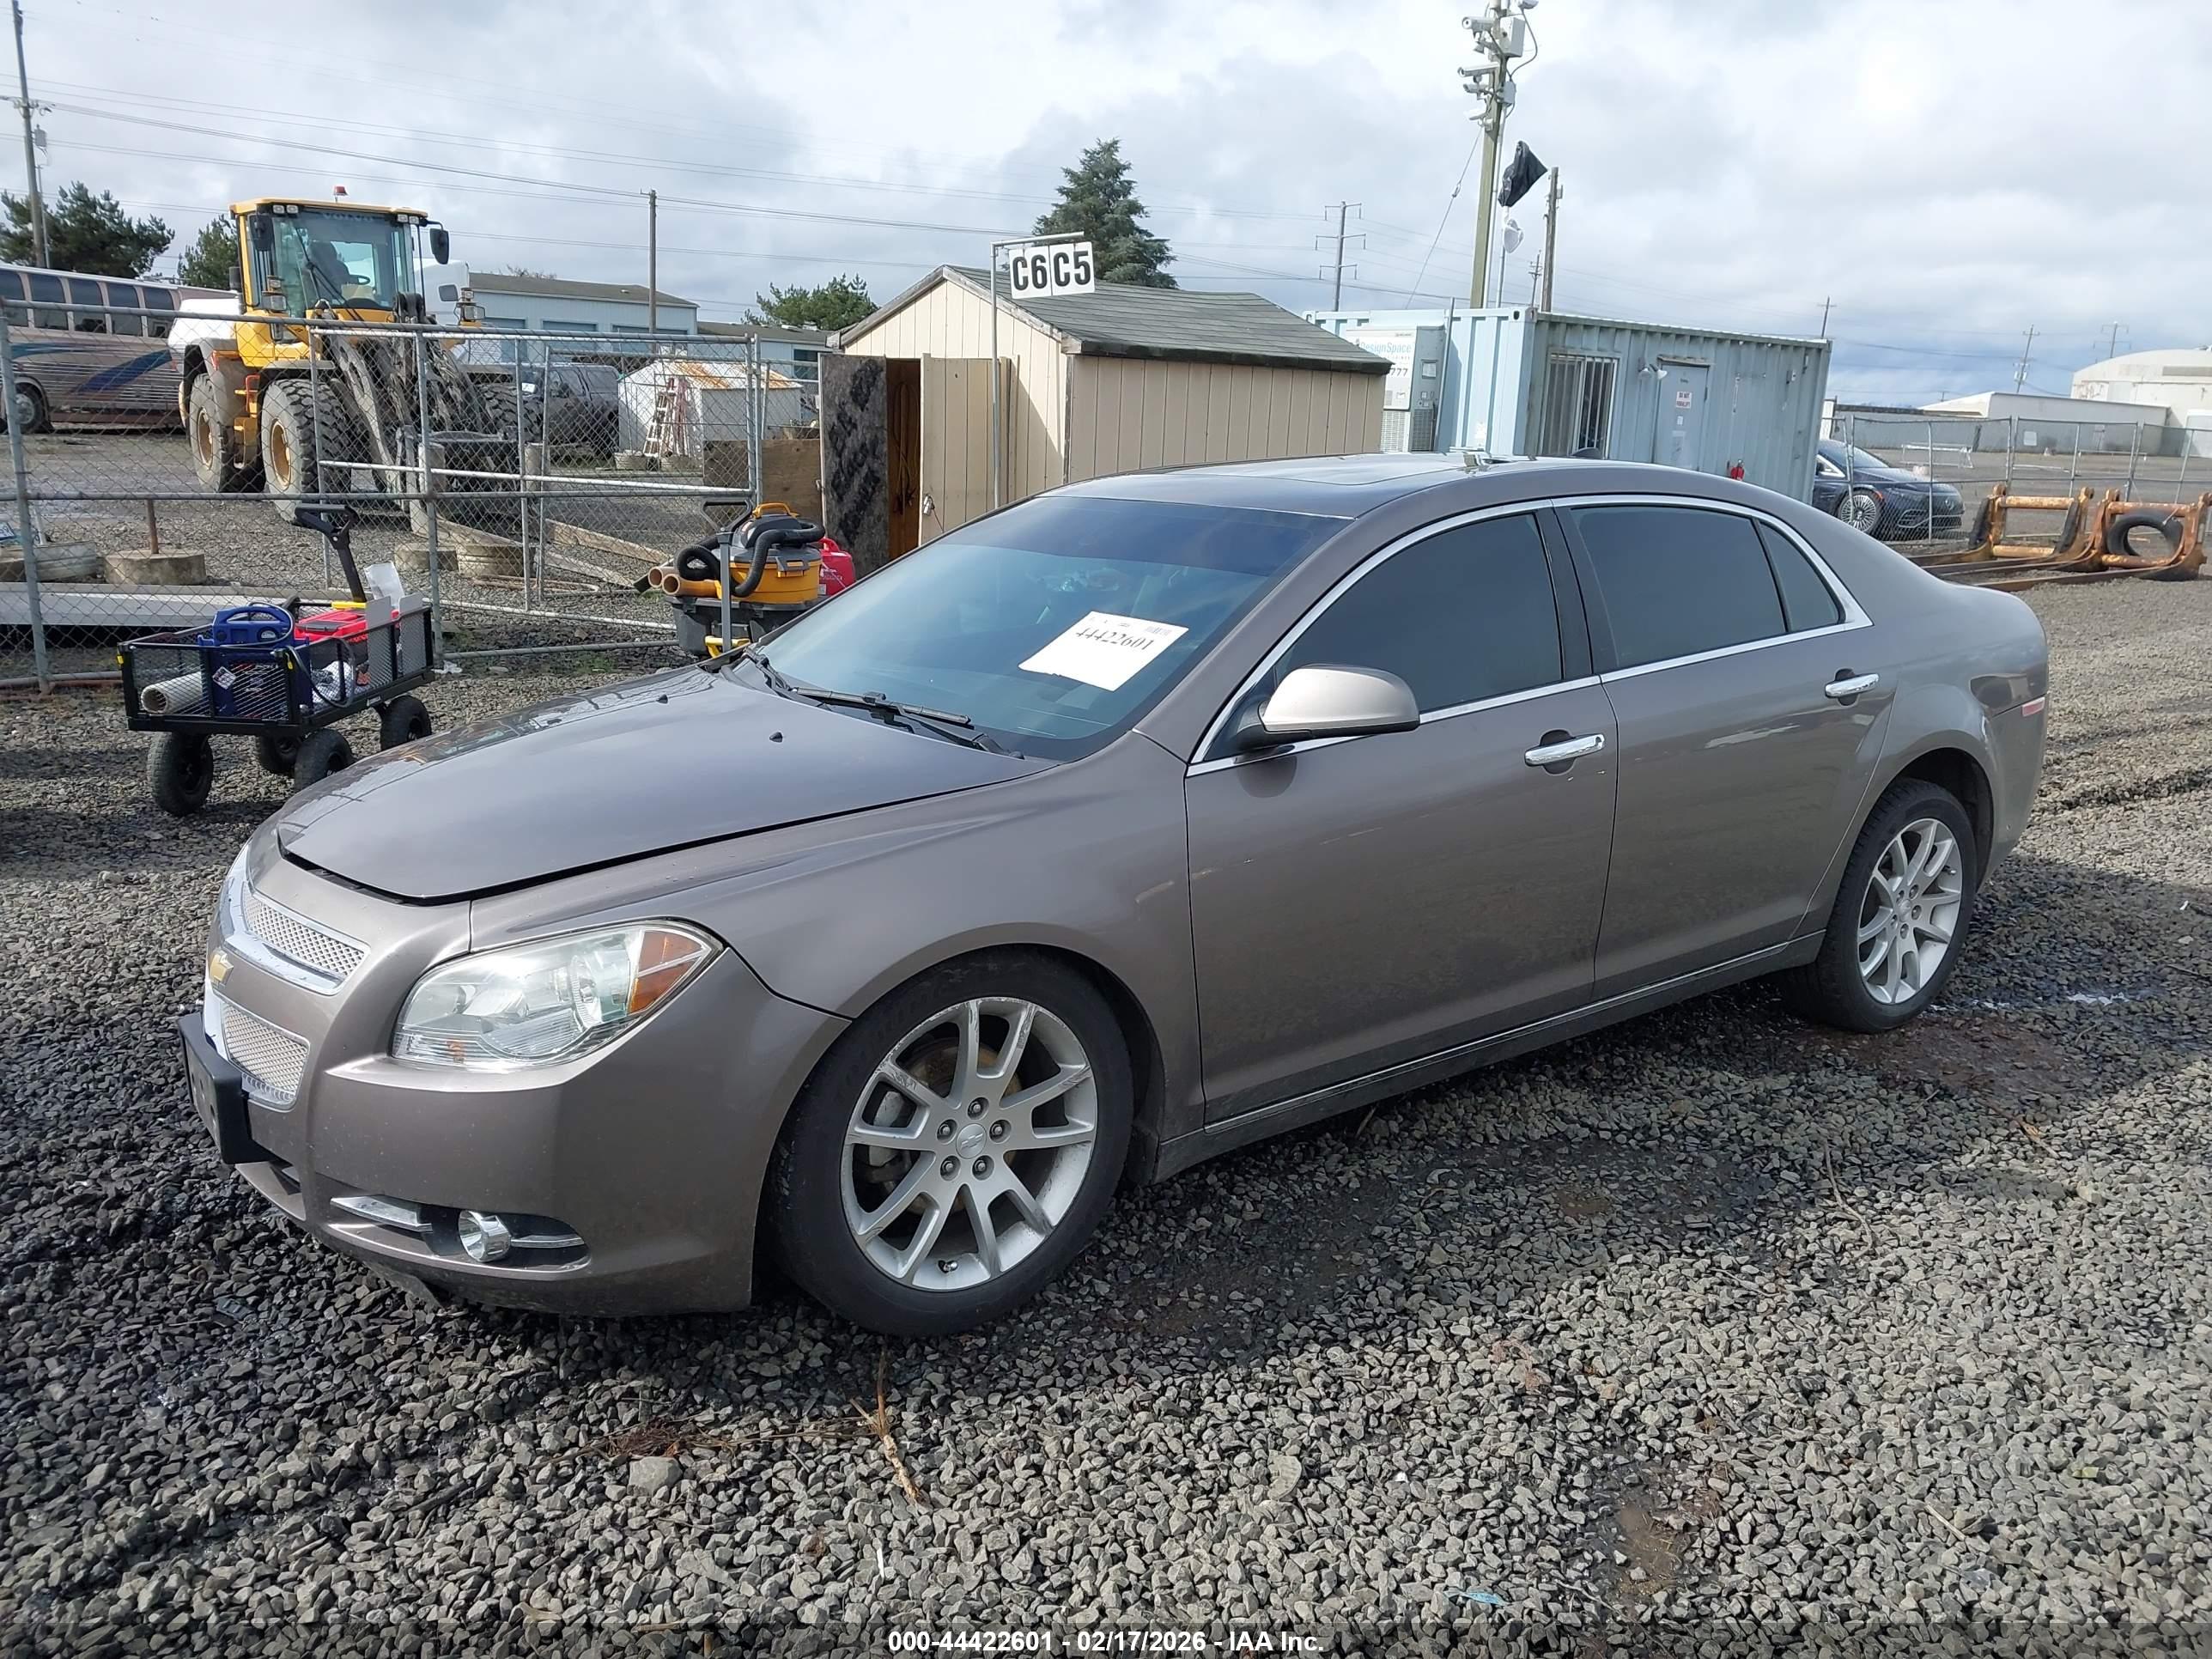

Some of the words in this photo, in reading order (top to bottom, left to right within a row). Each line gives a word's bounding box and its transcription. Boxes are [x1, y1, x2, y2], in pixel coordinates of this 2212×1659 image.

[1012, 254, 1048, 291] C6
[1053, 250, 1091, 287] C5
[1075, 627, 1155, 650] 44422601
